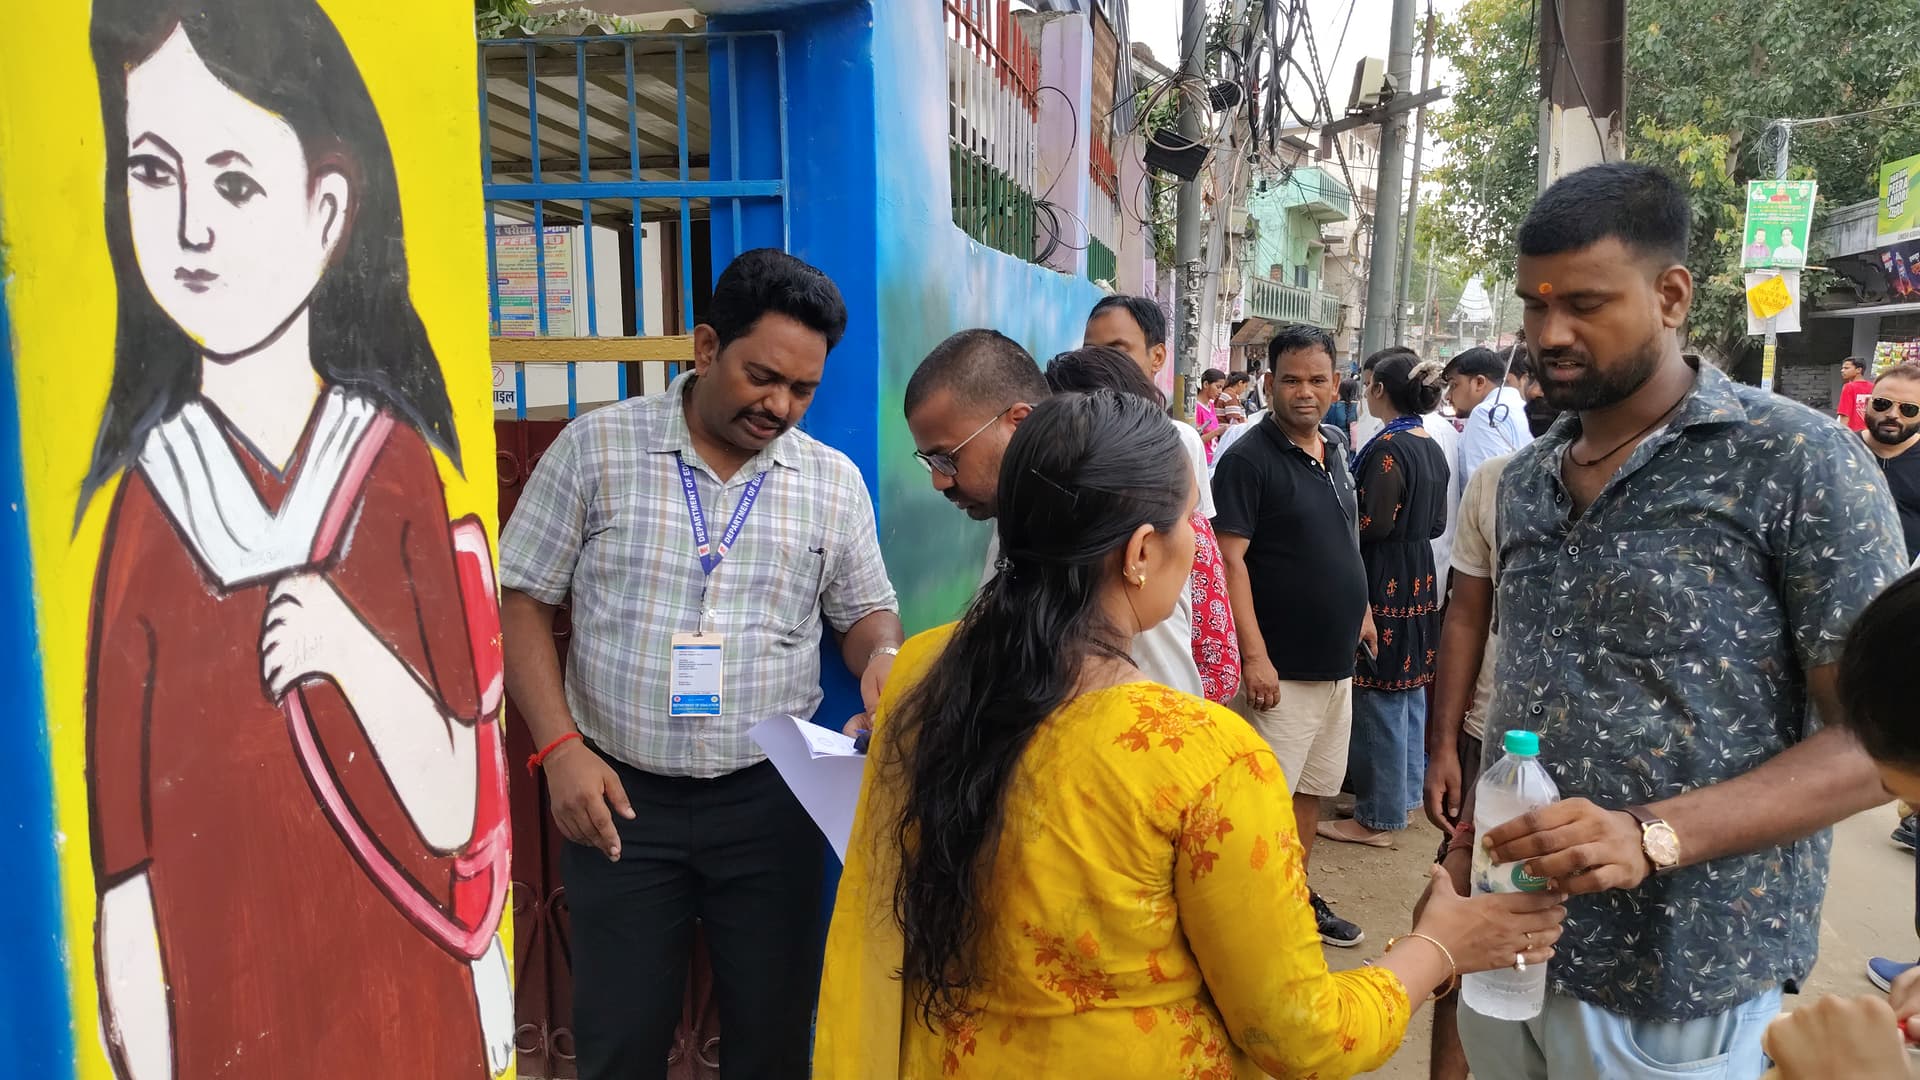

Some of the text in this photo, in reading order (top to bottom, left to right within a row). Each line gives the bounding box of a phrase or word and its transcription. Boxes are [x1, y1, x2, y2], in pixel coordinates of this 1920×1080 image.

[684, 478, 694, 488] OF
[688, 490, 706, 543] DEPARTMENT
[724, 496, 752, 544] DEPARTMENT
[747, 486, 757, 497] OF
